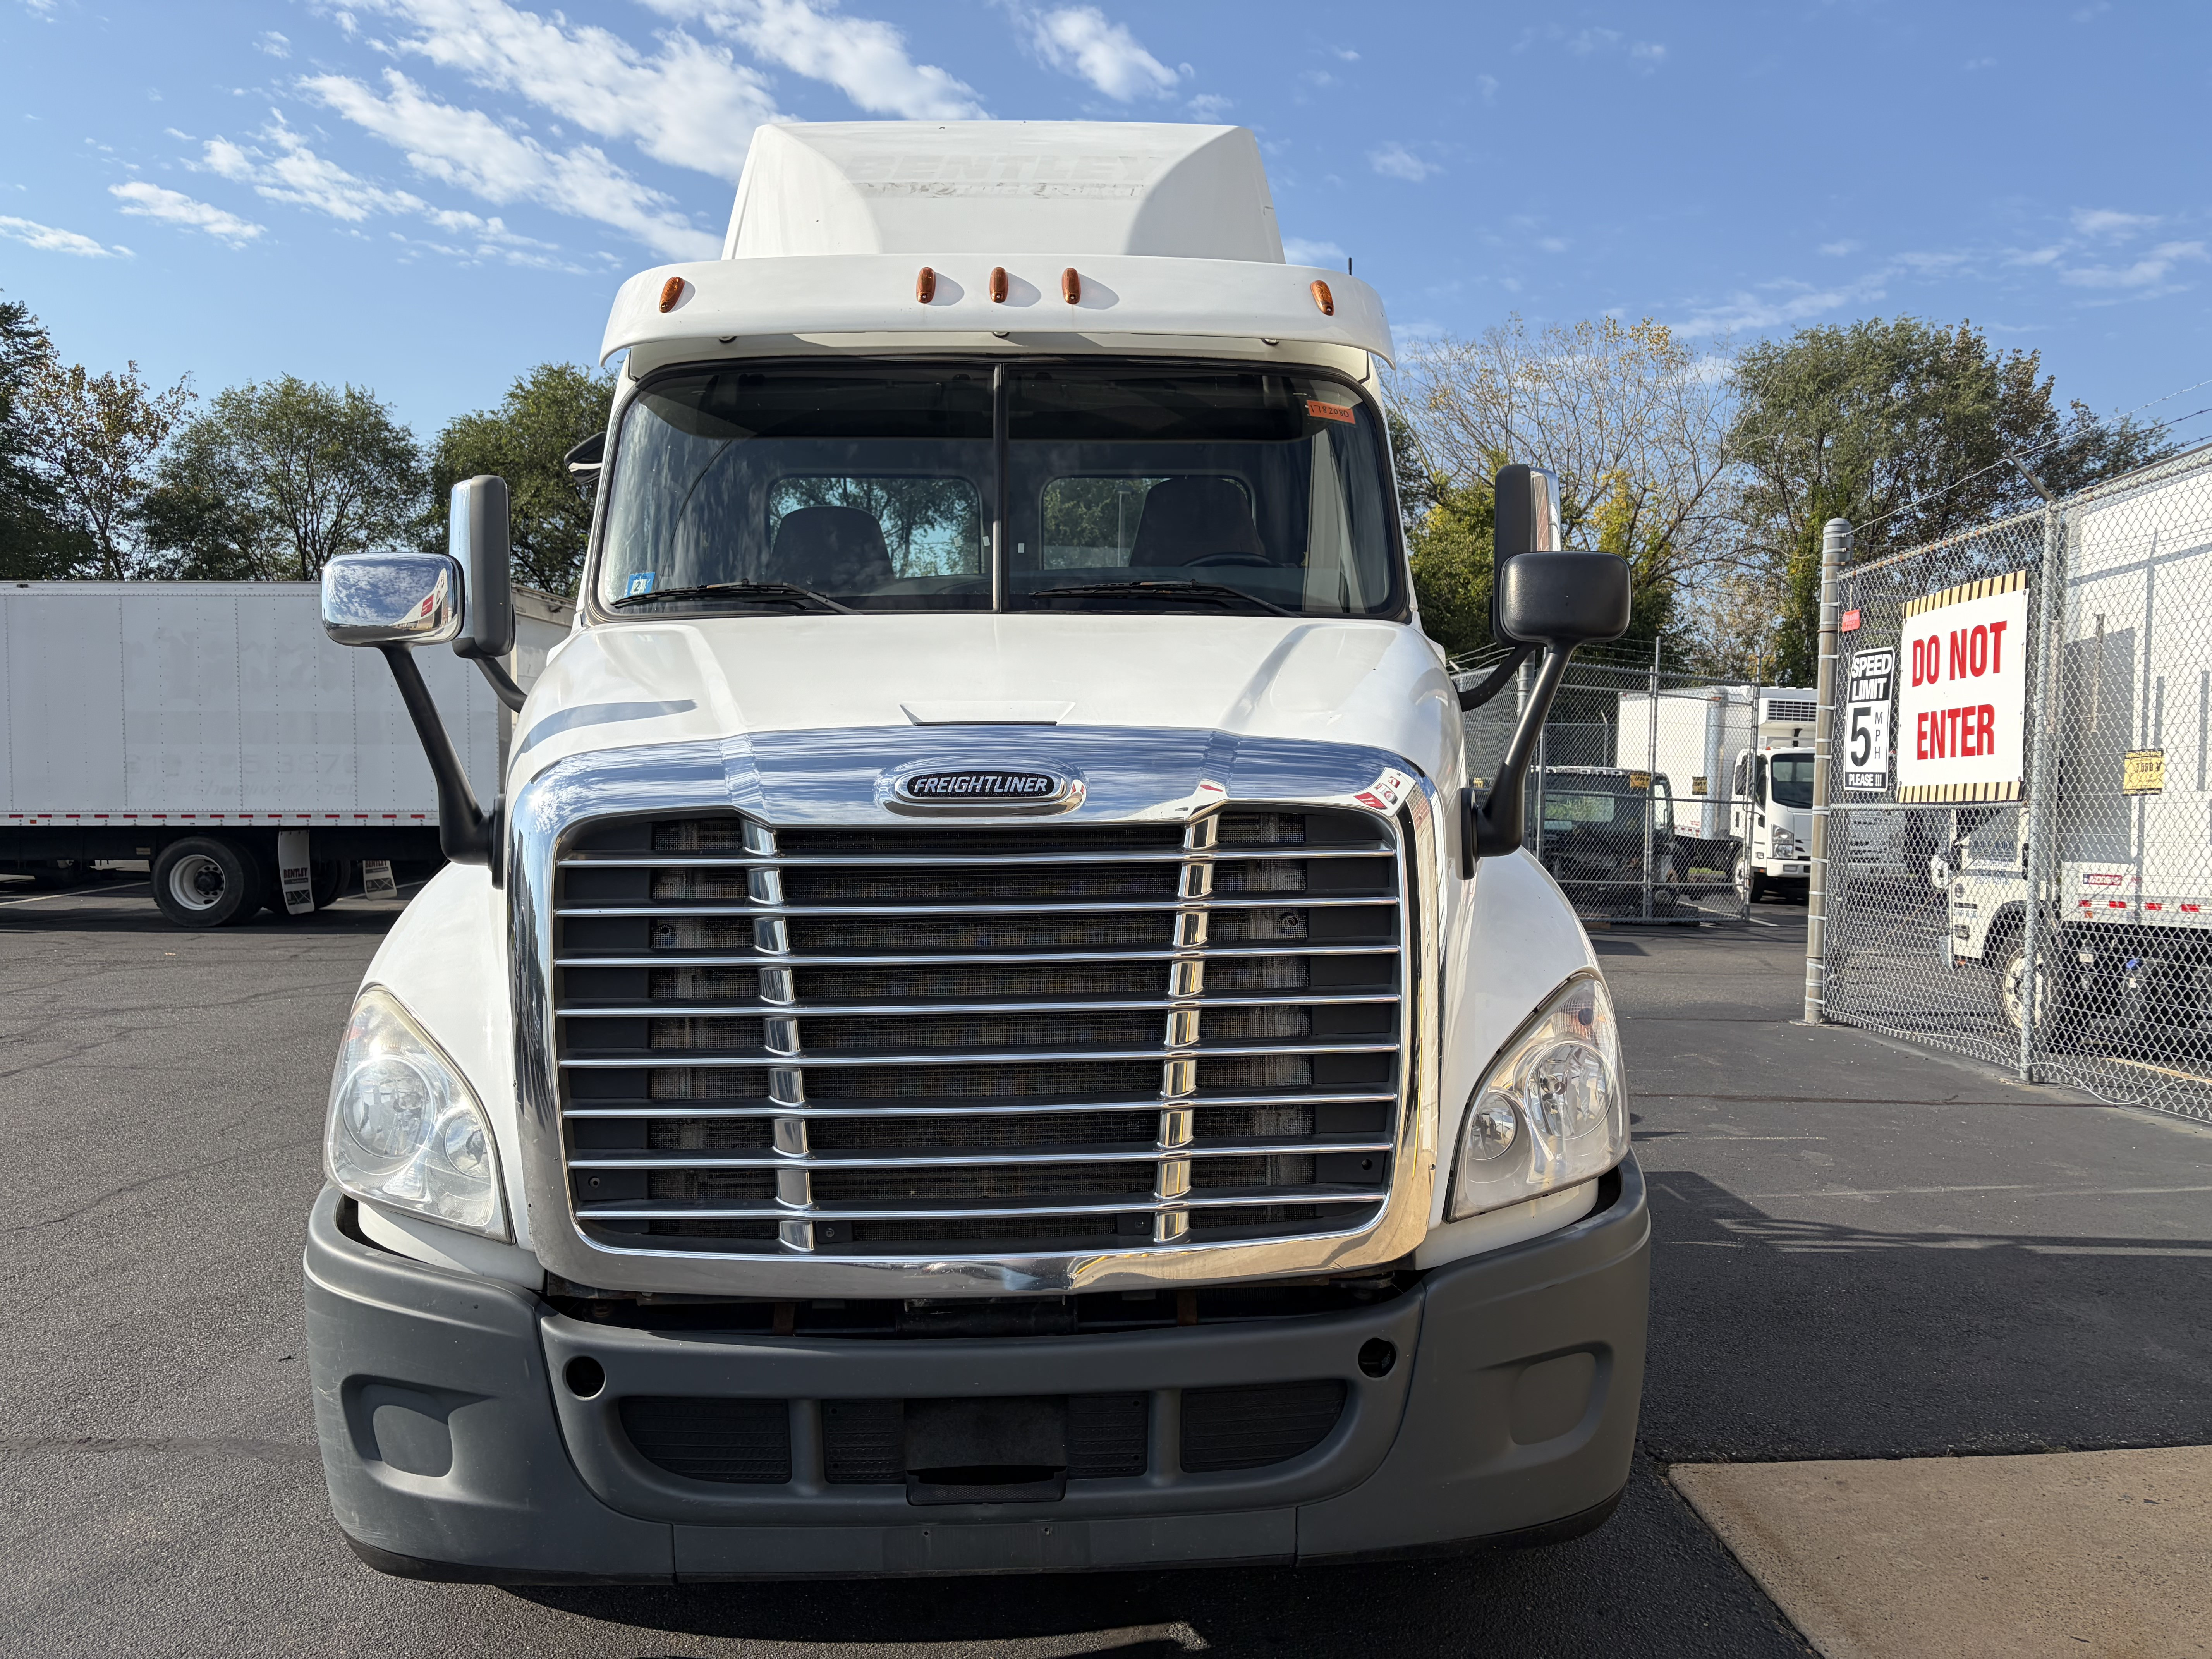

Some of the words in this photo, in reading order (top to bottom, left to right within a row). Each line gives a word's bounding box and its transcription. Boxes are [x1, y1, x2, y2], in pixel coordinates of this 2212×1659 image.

[1310, 404, 1349, 417] 1782080
[1852, 653, 1892, 678] SPEED
[1912, 635, 1940, 687] DO
[1950, 621, 2007, 680] NOT
[1852, 677, 1887, 701] LIMIT
[1851, 706, 1872, 767] 5
[1917, 704, 1995, 760] ENTER
[914, 776, 1048, 793] FREIGHTLINER
[1849, 774, 1874, 787] PLEASE
[283, 867, 308, 879] BENTLEY
